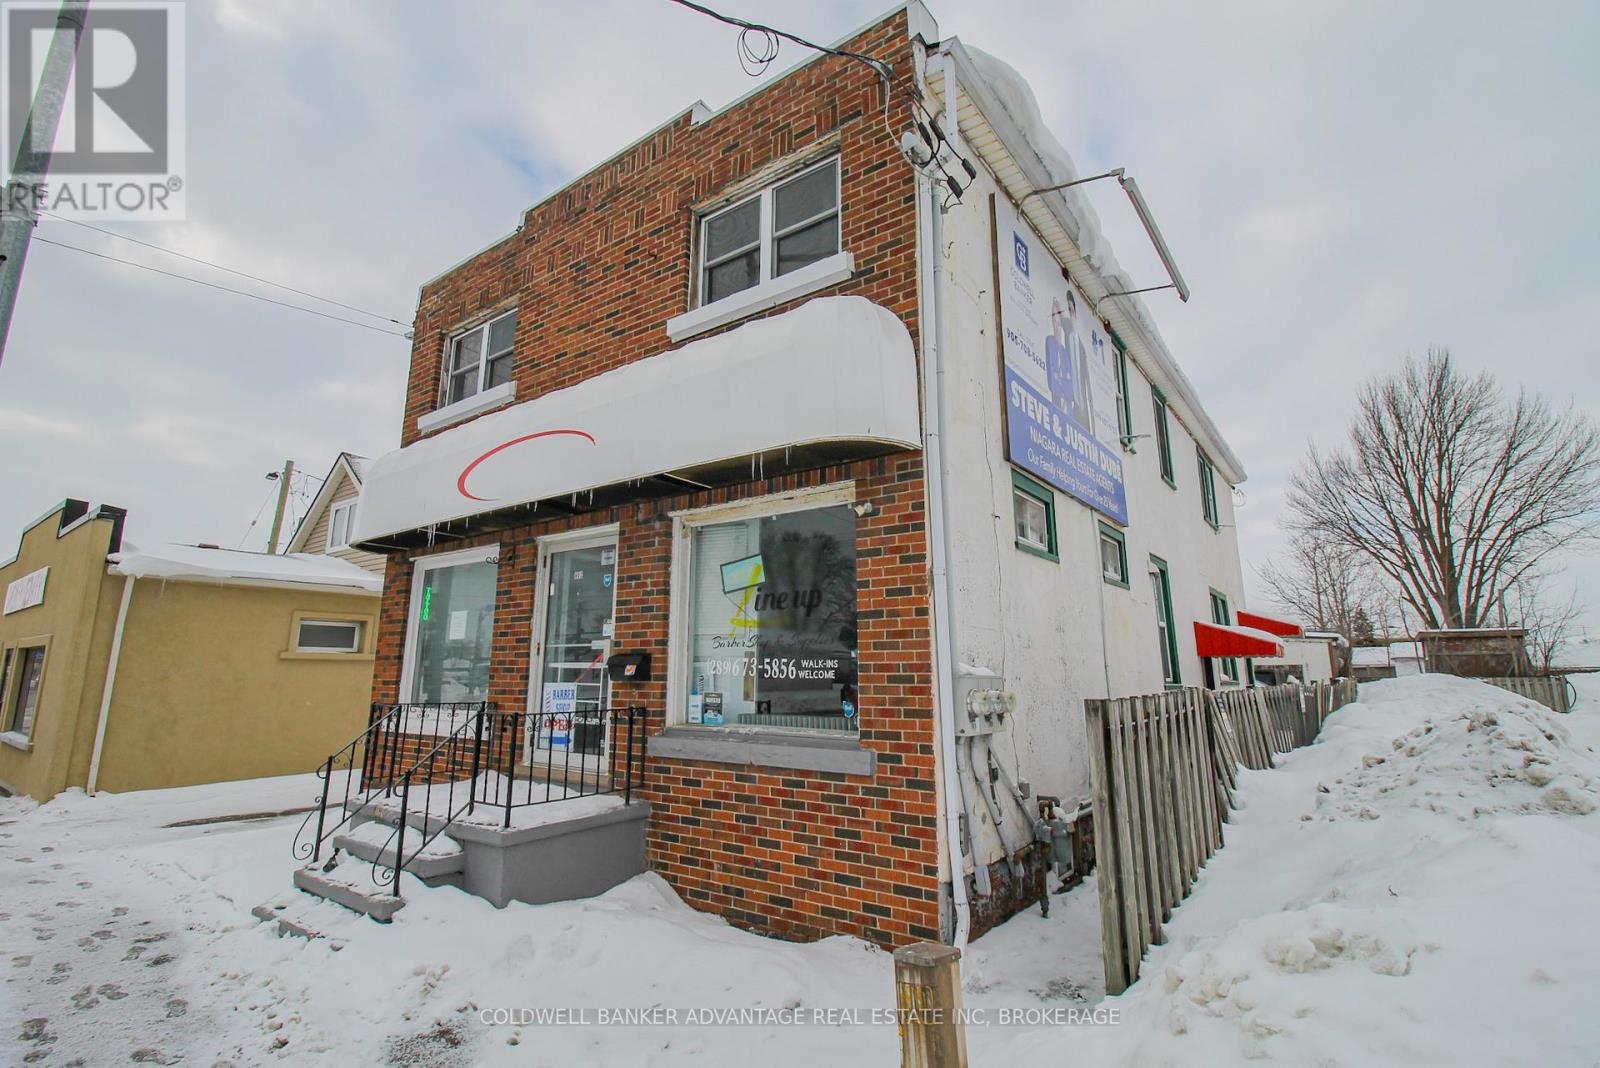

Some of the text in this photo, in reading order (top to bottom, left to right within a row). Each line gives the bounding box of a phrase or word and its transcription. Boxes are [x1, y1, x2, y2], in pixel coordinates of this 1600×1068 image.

[1010, 380, 1051, 430] STEVE
[1053, 413, 1063, 440] &
[1065, 424, 1099, 467] JUSTIN
[1029, 425, 1061, 458] NIAGARA
[1061, 447, 1077, 469] REAL
[1027, 447, 1040, 465] Our
[793, 589, 822, 617] up
[712, 635, 745, 649] Barber
[801, 659, 839, 669] WALK-INS
[798, 670, 836, 679] WELCOME
[553, 689, 575, 700] BARBER
